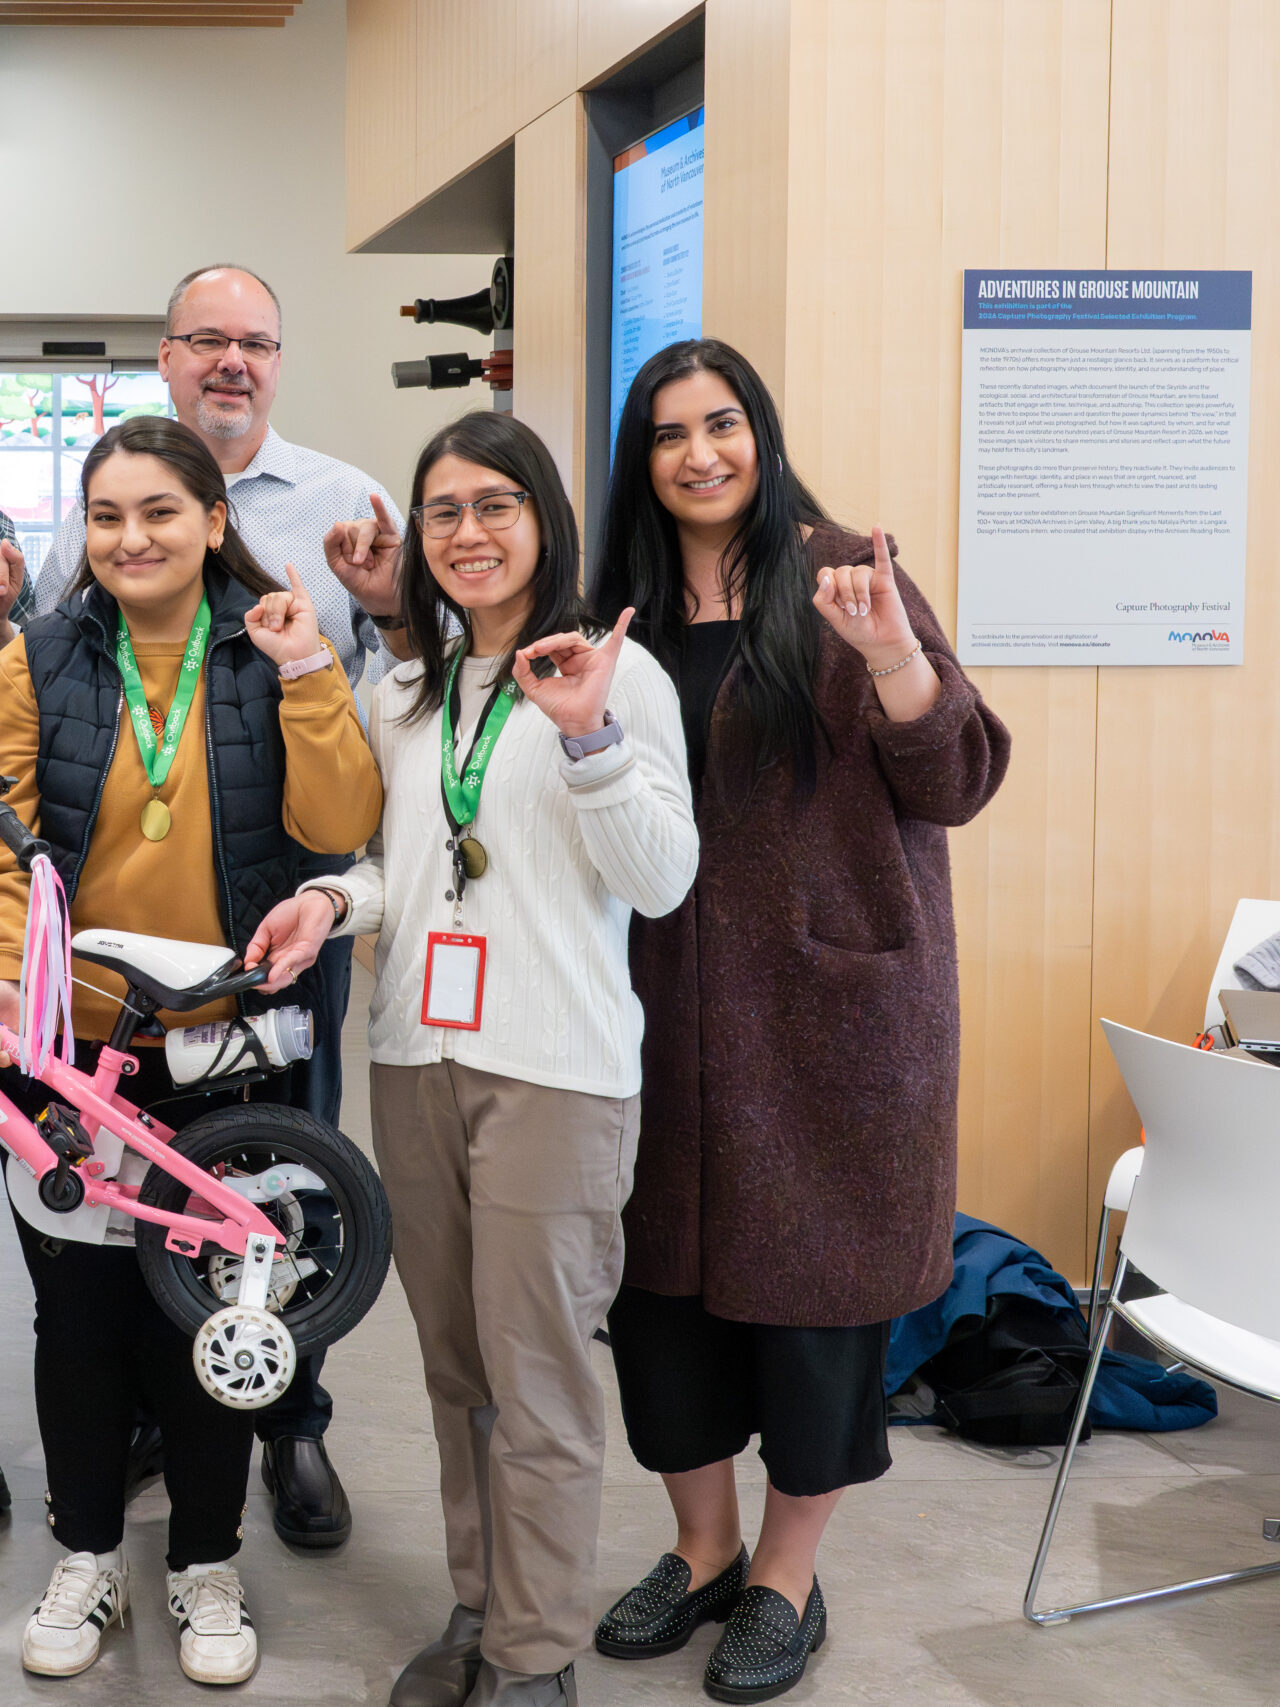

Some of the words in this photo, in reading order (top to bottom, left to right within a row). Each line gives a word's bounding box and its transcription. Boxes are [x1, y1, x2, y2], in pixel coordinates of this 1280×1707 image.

[978, 280, 1060, 298] ADVENTURES
[1062, 281, 1076, 298] IN
[1078, 280, 1129, 299] GROUSE
[1132, 280, 1199, 300] MOUNTAIN
[1116, 602, 1148, 612] Capture
[1150, 602, 1200, 613] Photography
[1202, 602, 1230, 611] Festival
[119, 641, 134, 672] Outback
[188, 626, 205, 658] Outback
[139, 718, 154, 750] Outback
[166, 708, 182, 743] Outback
[470, 735, 492, 770] Outback
